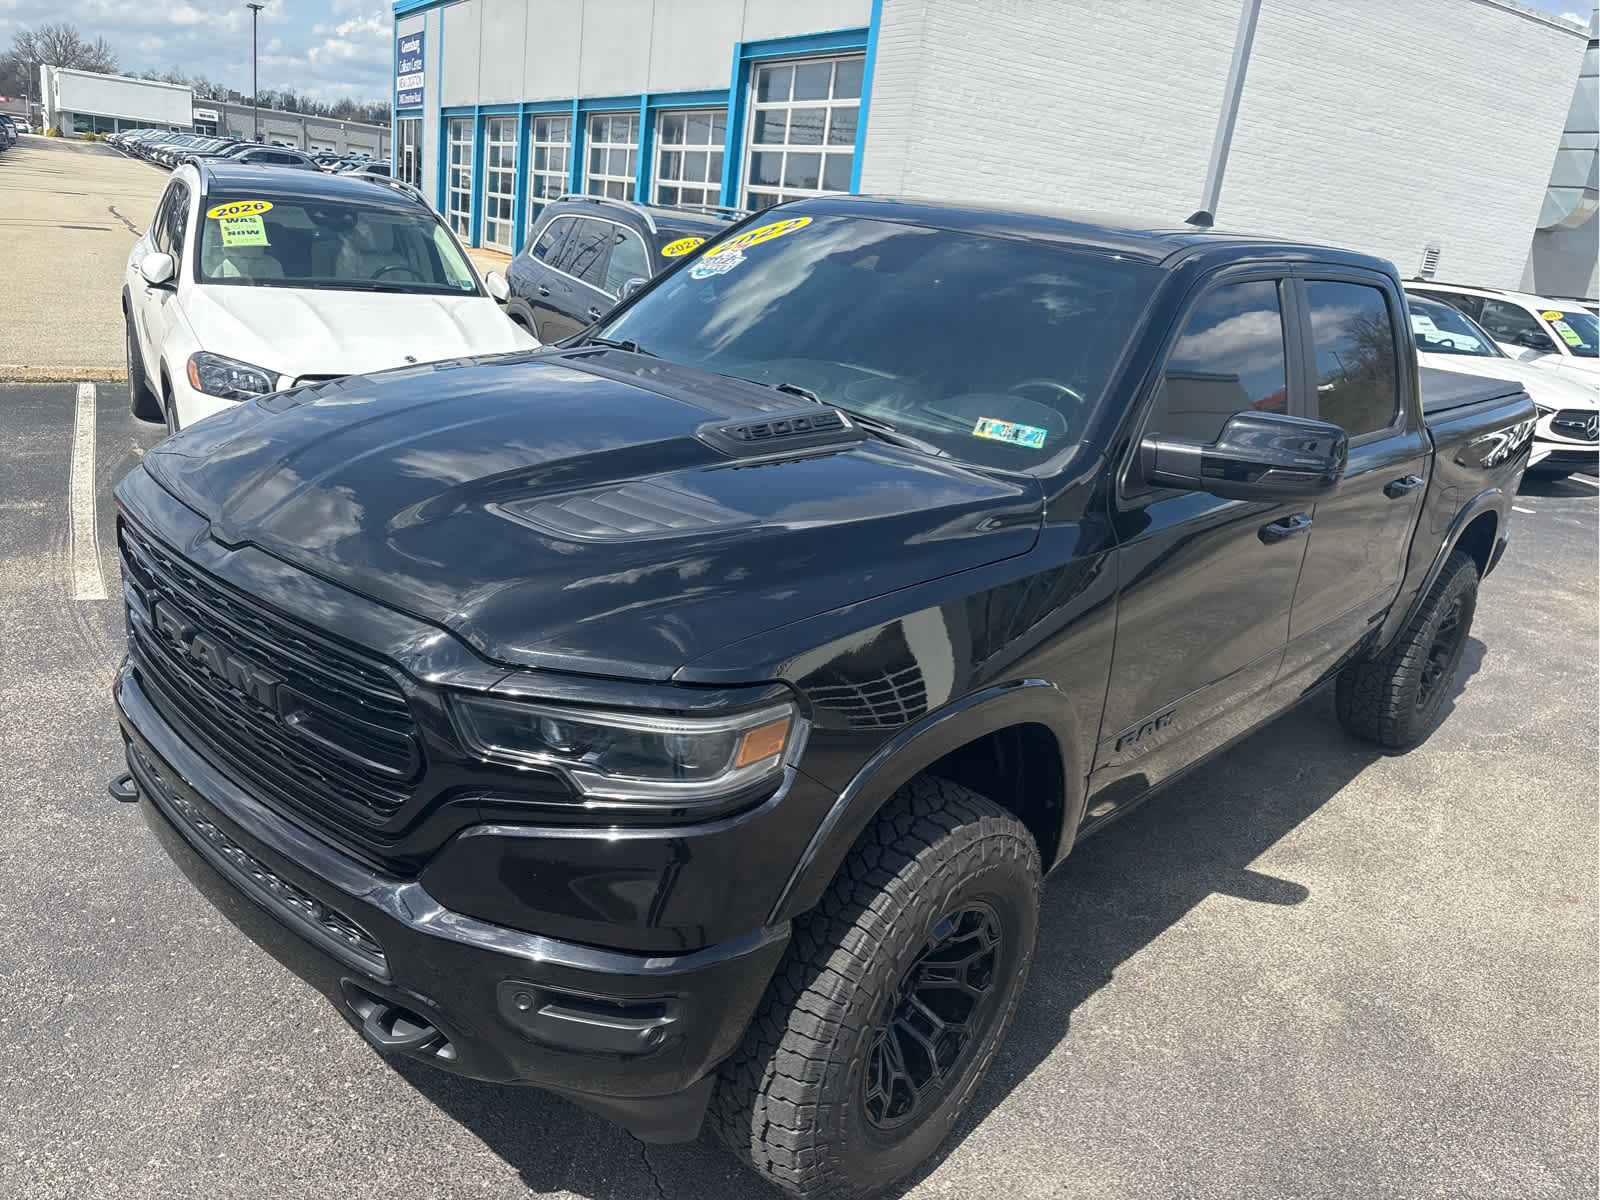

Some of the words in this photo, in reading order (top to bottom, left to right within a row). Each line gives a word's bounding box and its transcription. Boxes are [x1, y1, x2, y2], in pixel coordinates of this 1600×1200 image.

[401, 37, 420, 54] Greensburg
[399, 58, 412, 73] Collision
[411, 57, 422, 71] Center
[216, 203, 265, 217] 2026
[713, 219, 803, 256] 2022
[667, 239, 702, 256] 2024
[156, 600, 284, 716] RAM
[1115, 709, 1177, 752] RAM
